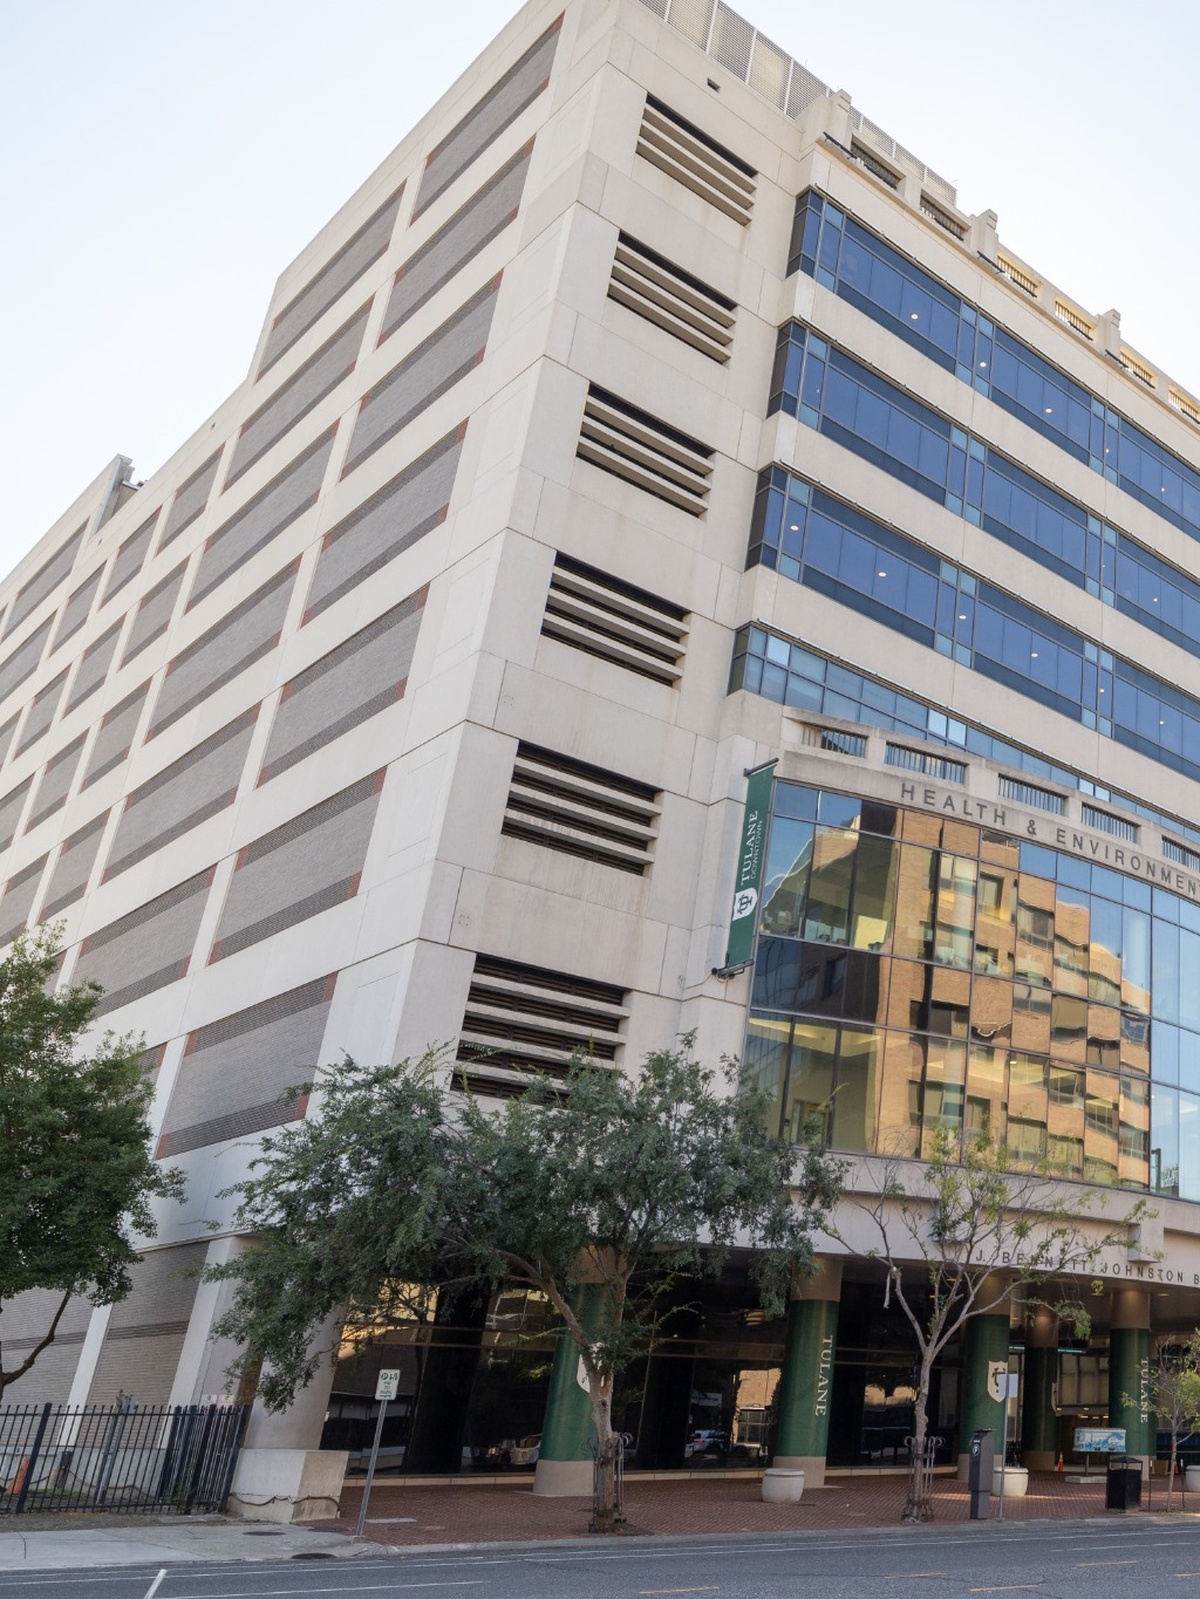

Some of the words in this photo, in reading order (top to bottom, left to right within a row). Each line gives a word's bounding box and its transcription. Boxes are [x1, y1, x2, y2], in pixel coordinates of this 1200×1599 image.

[901, 783, 1005, 825] HEALTH
[1026, 819, 1038, 836] &
[741, 810, 758, 886] TULANE
[750, 820, 763, 880] DOWNTOWN
[975, 1251, 986, 1263] J.
[1101, 1262, 1183, 1283] JOHNSTON
[815, 1335, 833, 1416] TULANE
[1140, 1356, 1149, 1423] TULANE
